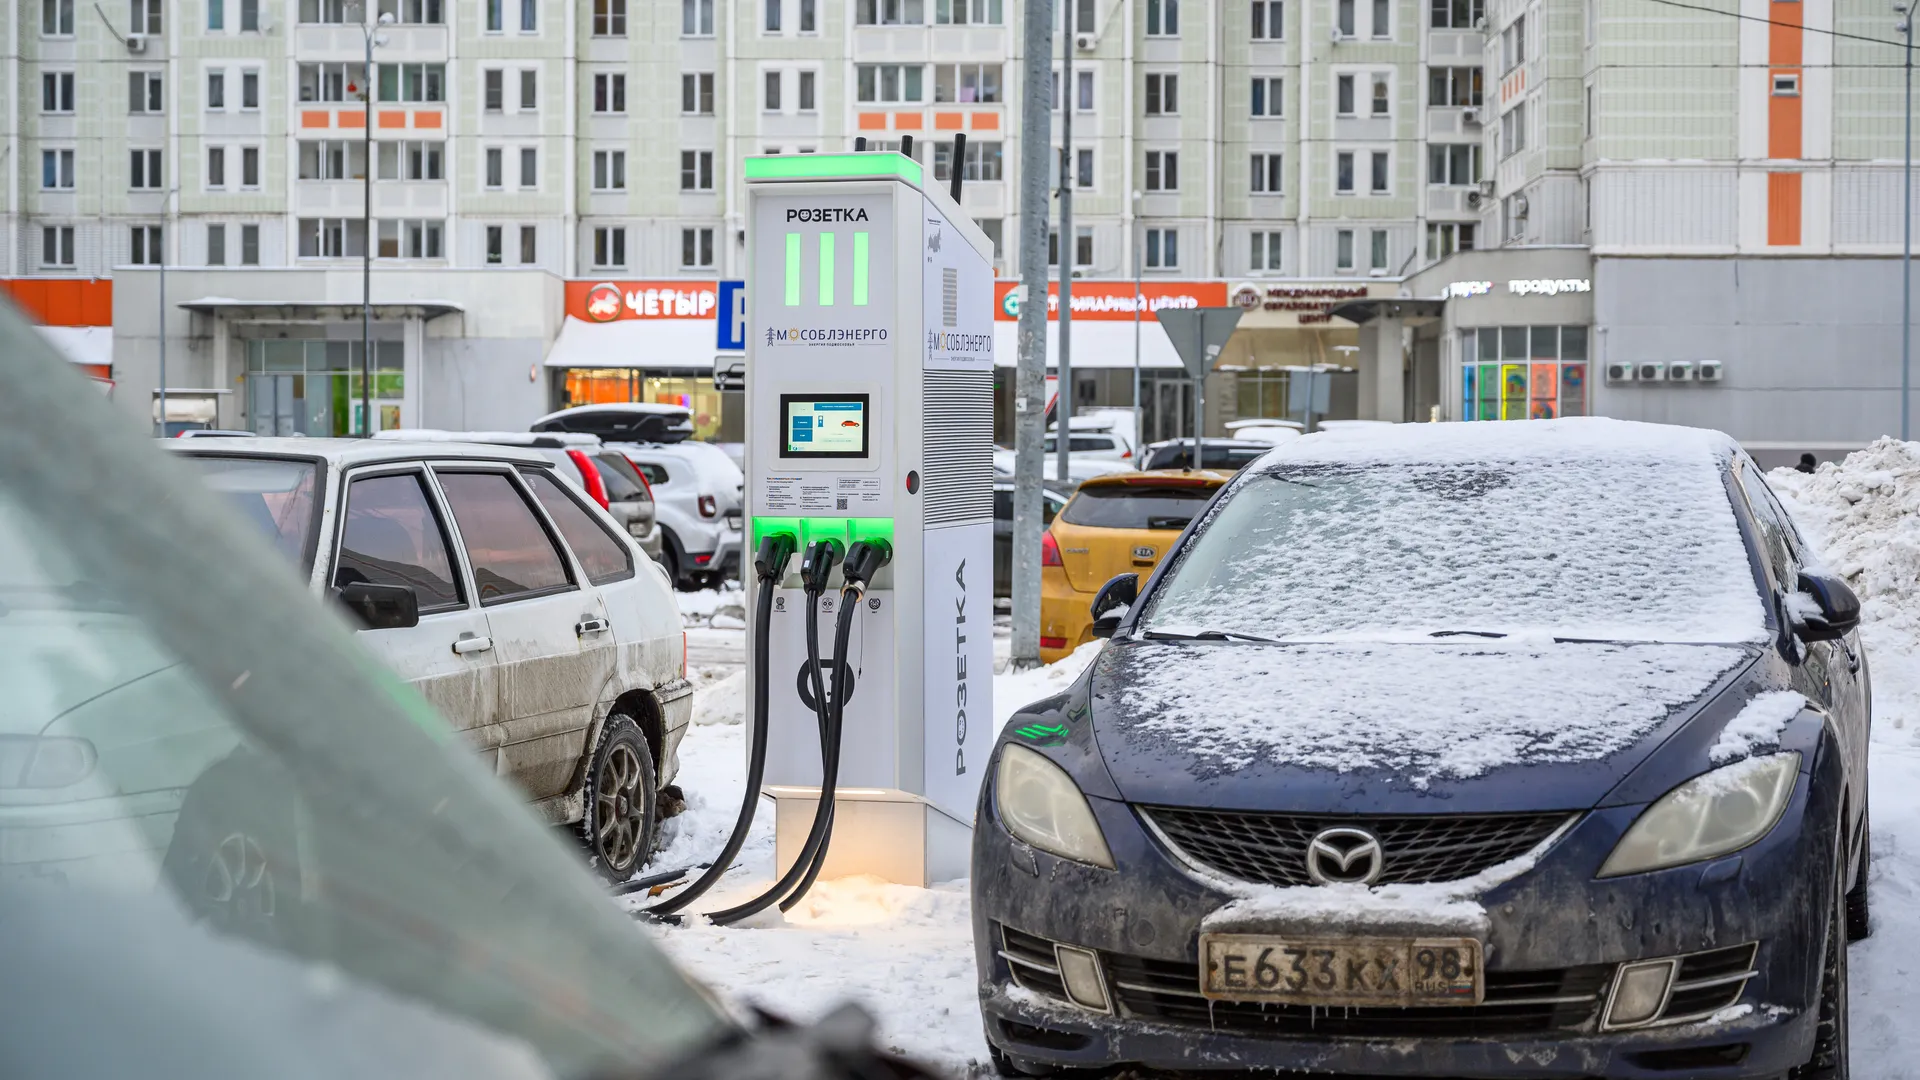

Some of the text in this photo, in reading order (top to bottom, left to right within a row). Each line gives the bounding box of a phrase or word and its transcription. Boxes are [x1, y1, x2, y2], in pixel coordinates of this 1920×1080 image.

[786, 208, 869, 223] РОЗЕТКА
[1267, 286, 1368, 300] МЕЖДУНАРОДНЫЙ
[1508, 278, 1591, 296] продукты
[625, 288, 716, 315] ЧЕТЫР
[1149, 295, 1199, 313] ЦЕНТР
[1264, 301, 1338, 312] ОБРАЗОВАТЕ
[1298, 313, 1333, 325] ЦЕНТР
[776, 327, 888, 342] МОСОБЛЭНЕРГО
[933, 331, 992, 353] МОСОБЛЭНЕРГО
[956, 558, 967, 776] РОЗЕТКА
[1416, 949, 1462, 981] 98
[1415, 982, 1449, 993] RUS
